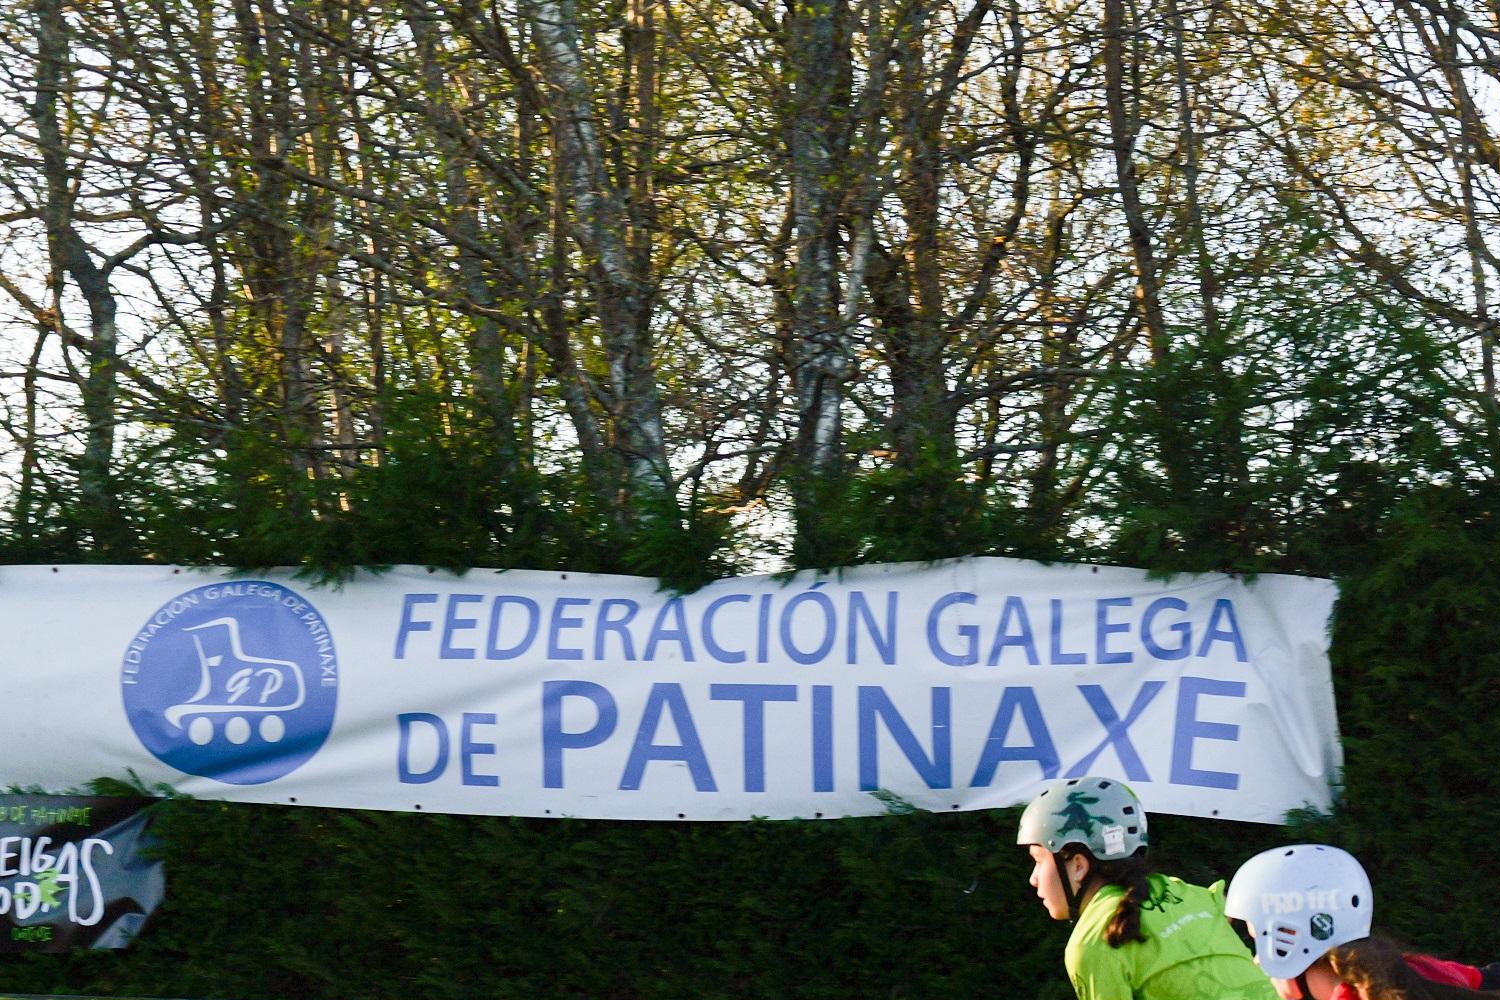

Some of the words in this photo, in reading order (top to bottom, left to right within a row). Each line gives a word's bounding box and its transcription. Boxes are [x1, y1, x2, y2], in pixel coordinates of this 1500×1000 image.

[204, 584, 283, 601] GALEGA
[281, 596, 308, 615] DE
[300, 612, 338, 687] PATINAXE
[394, 581, 899, 666] FEDERACIÓN
[925, 591, 1248, 668] GALEGA
[396, 712, 500, 788] DE
[541, 676, 1247, 794] PATINAXE
